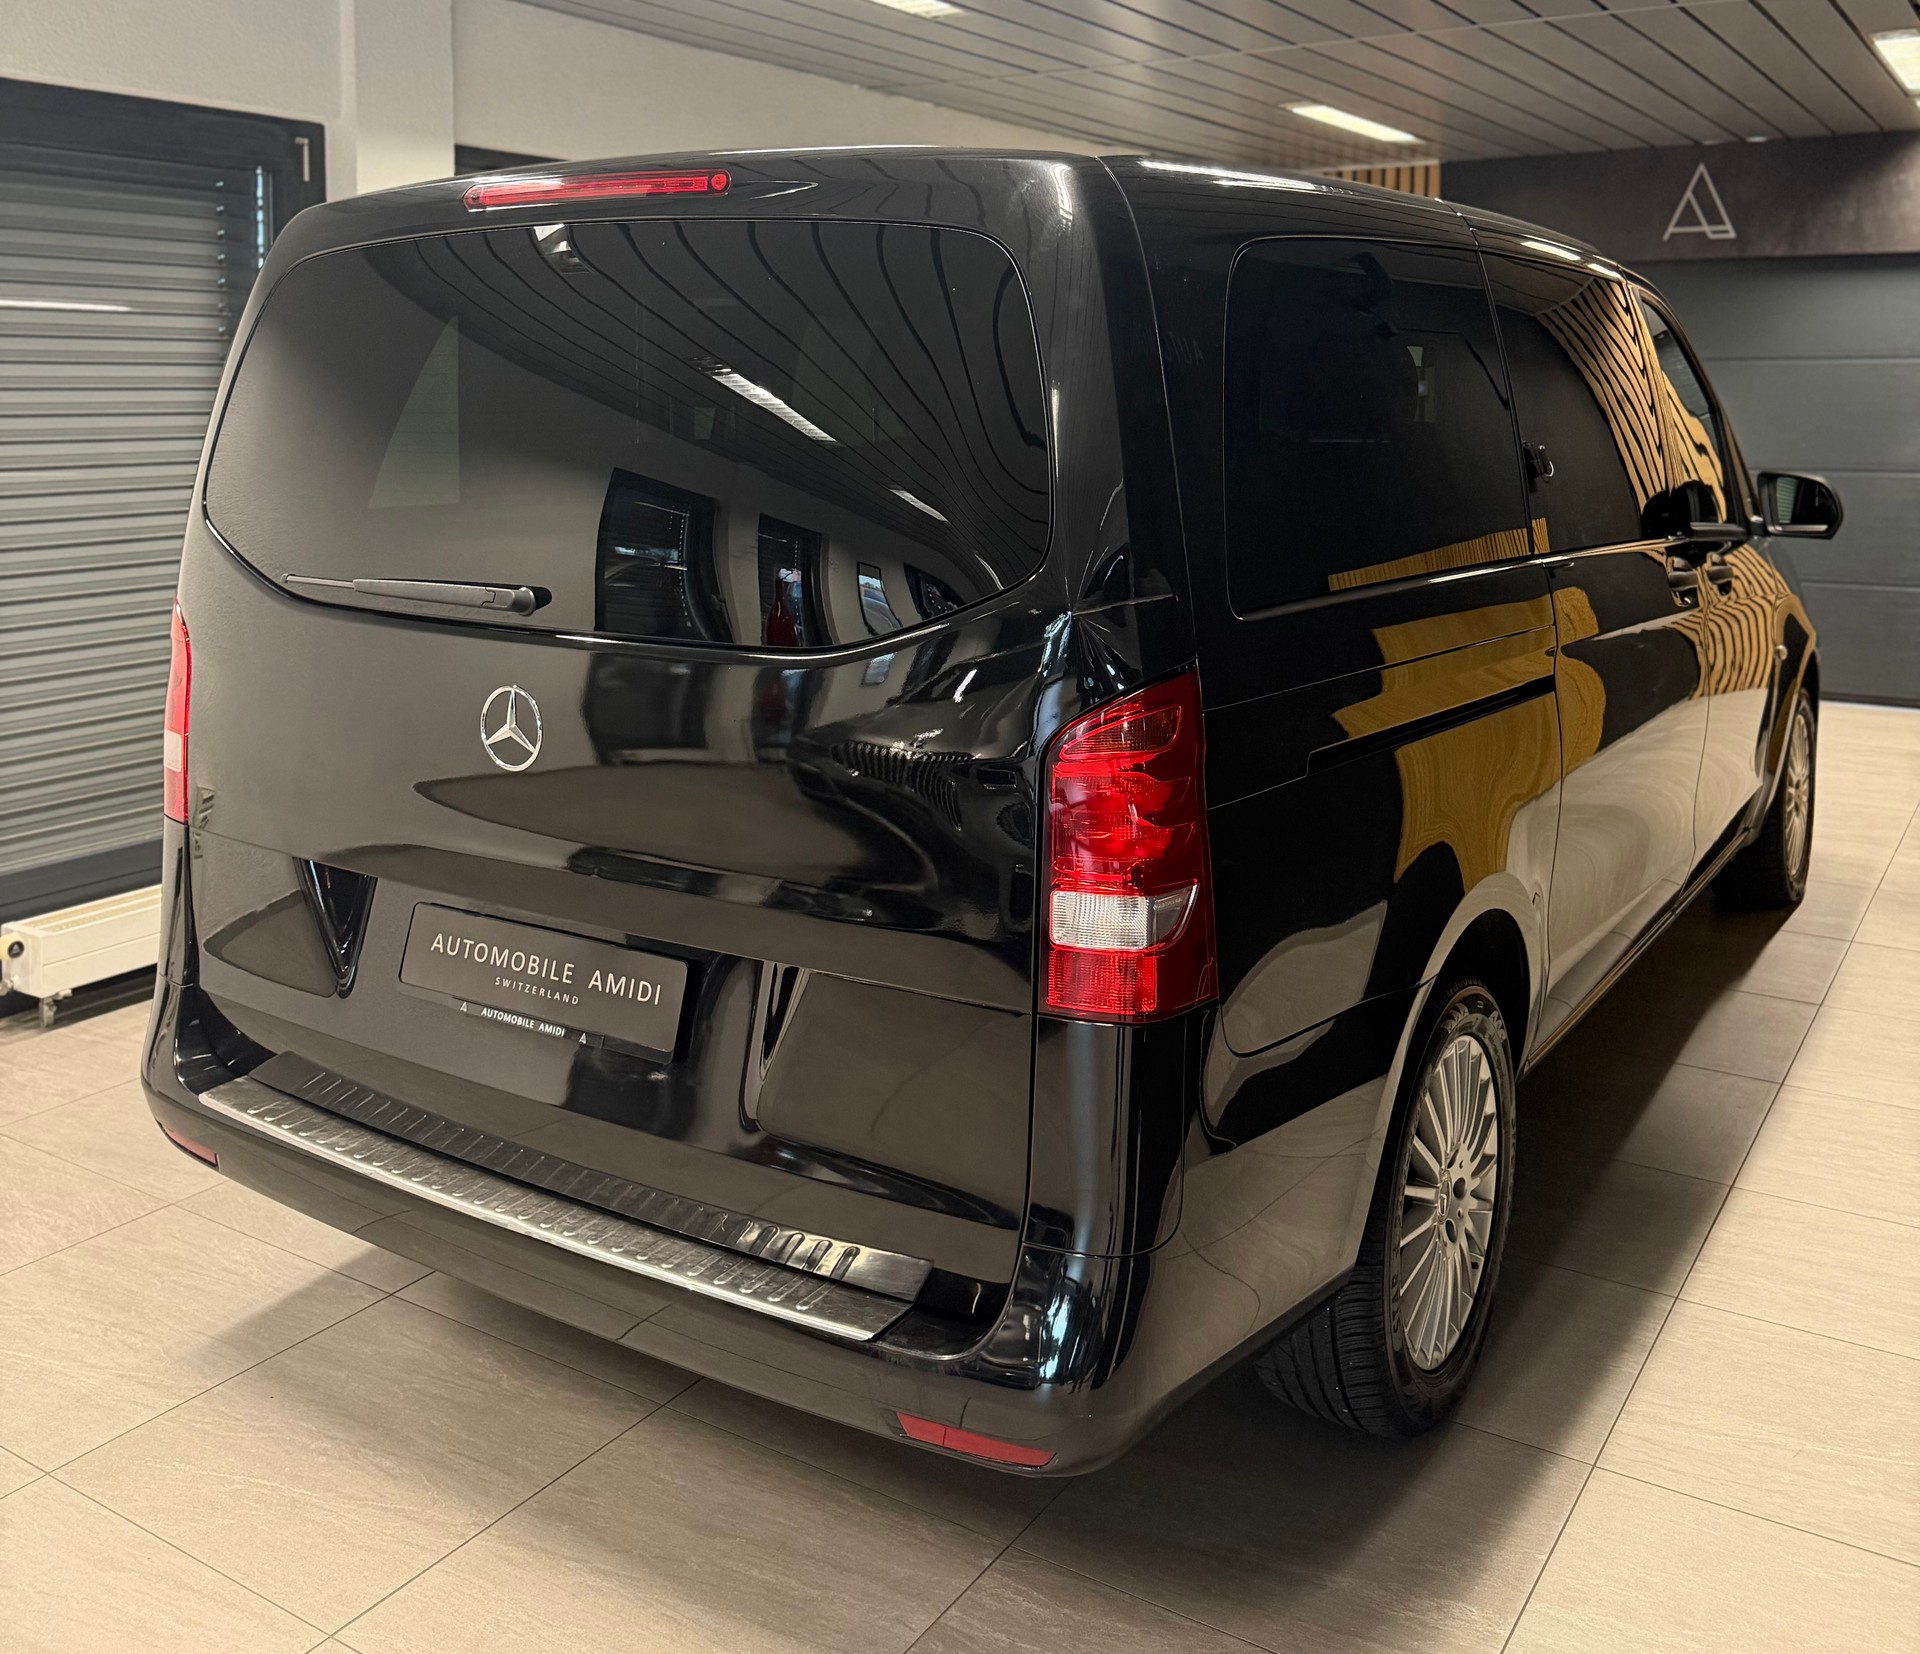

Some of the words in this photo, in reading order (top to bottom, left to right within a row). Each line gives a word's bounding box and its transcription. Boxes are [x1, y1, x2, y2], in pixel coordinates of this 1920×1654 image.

[430, 933, 575, 984] AUTOMOBILE
[588, 970, 661, 1005] AMIDI
[495, 976, 579, 1005] SWITZERLAND
[481, 1007, 535, 1029] AUTOMOBILE
[538, 1022, 565, 1037] AMIDI
